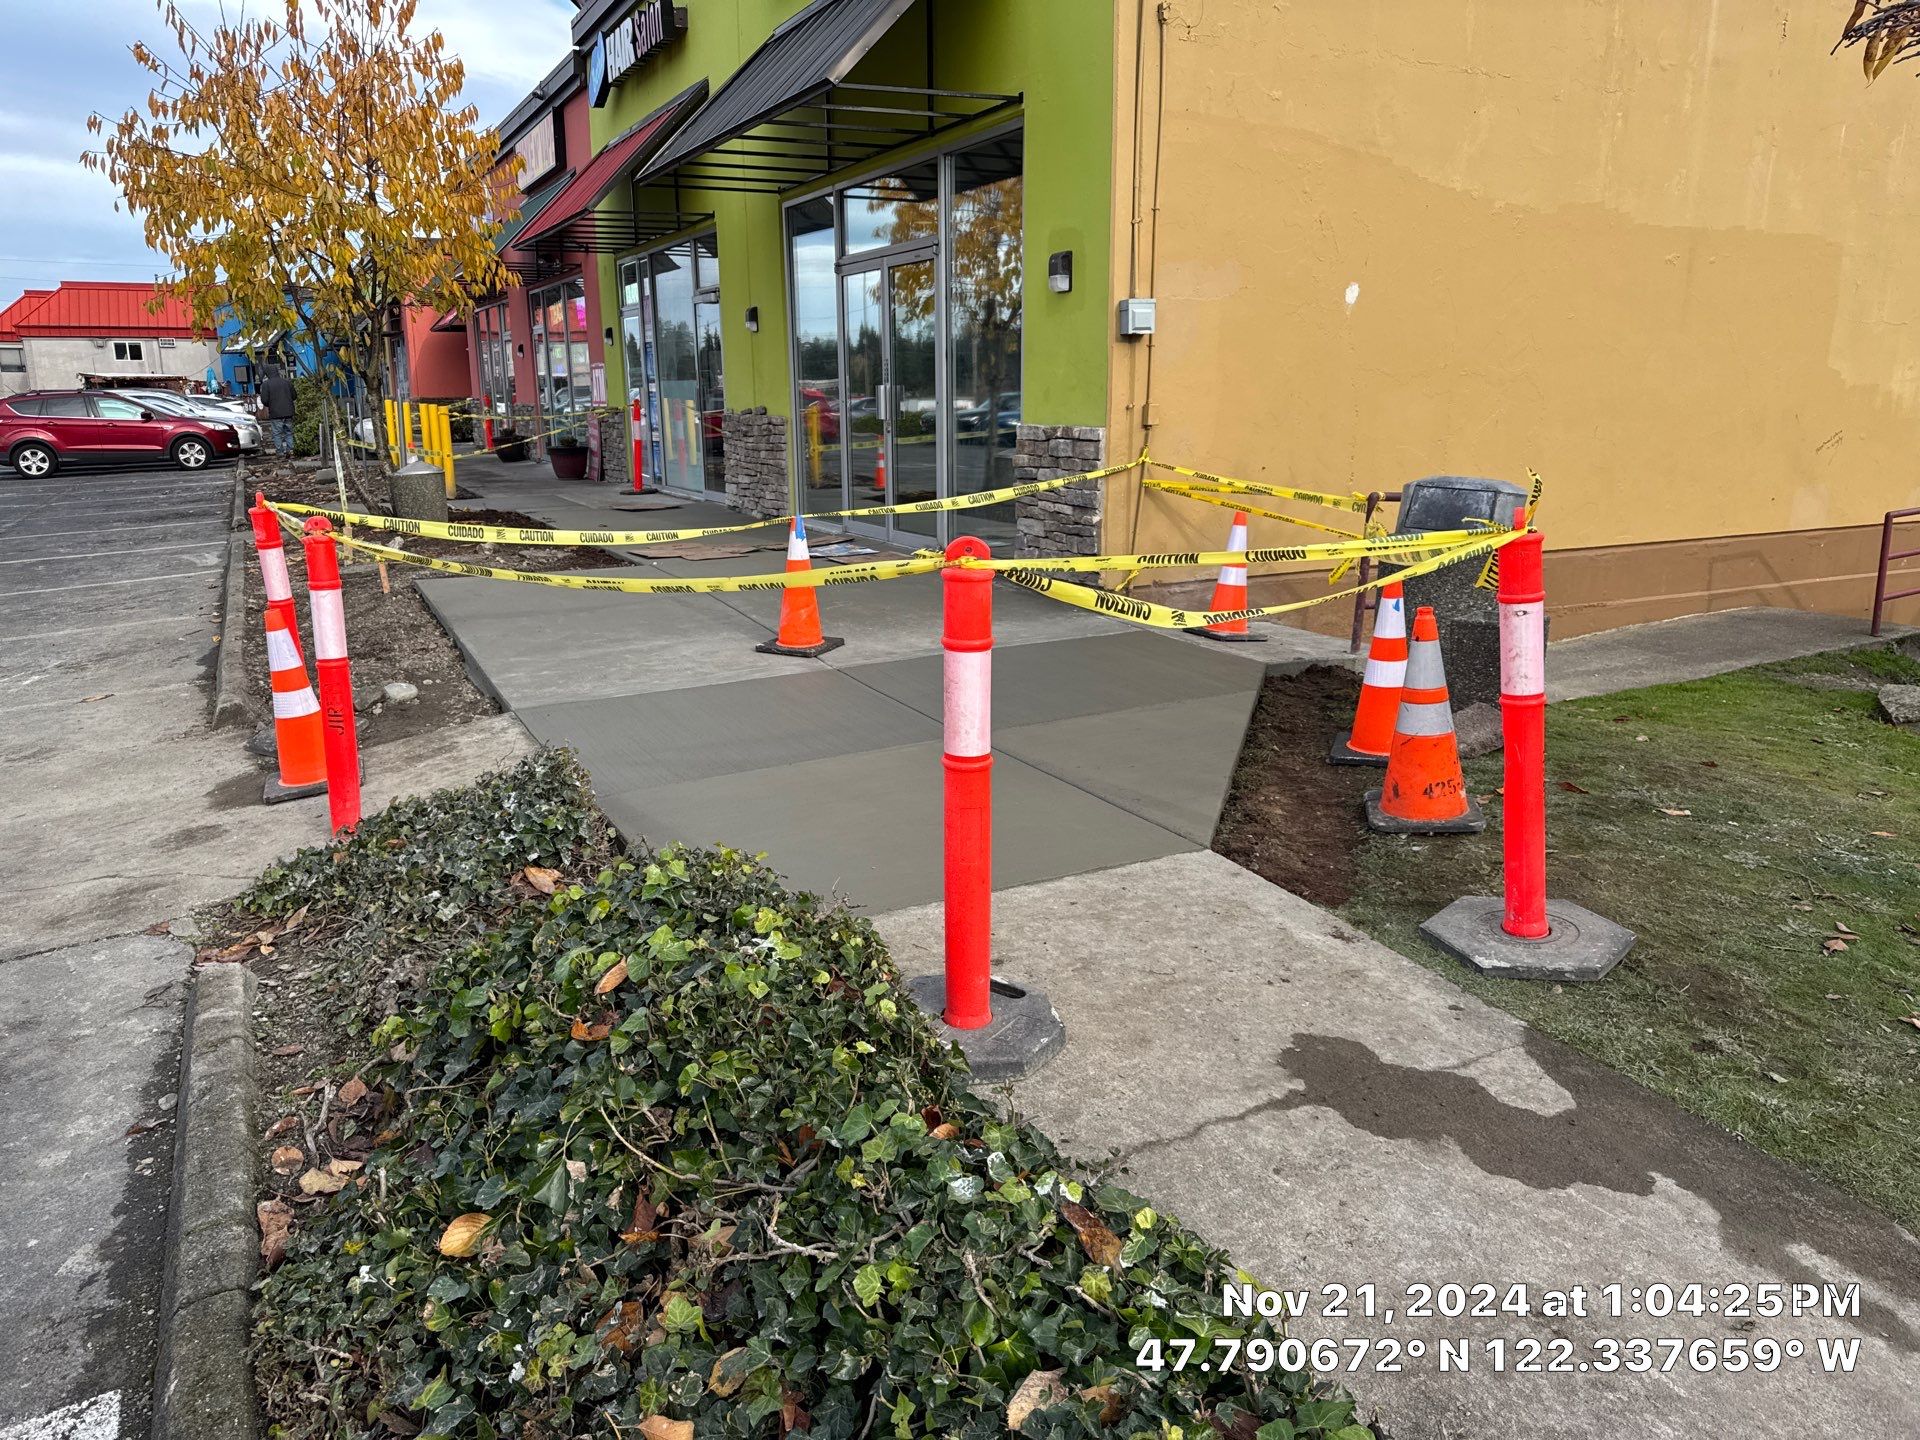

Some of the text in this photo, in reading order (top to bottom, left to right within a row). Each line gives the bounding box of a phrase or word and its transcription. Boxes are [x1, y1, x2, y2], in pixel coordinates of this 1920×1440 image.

[605, 0, 664, 84] HAIR Salon
[915, 500, 944, 511] CUIDADO
[967, 492, 995, 505] CAUTION
[1012, 484, 1040, 497] CUIDADO
[383, 518, 421, 534] CAUTION
[447, 525, 485, 539] CUIDADO
[519, 529, 554, 543] CAUTION
[579, 532, 614, 544] CUIDADO
[646, 531, 679, 542] CAUTION
[1094, 588, 1152, 621] CAUTION
